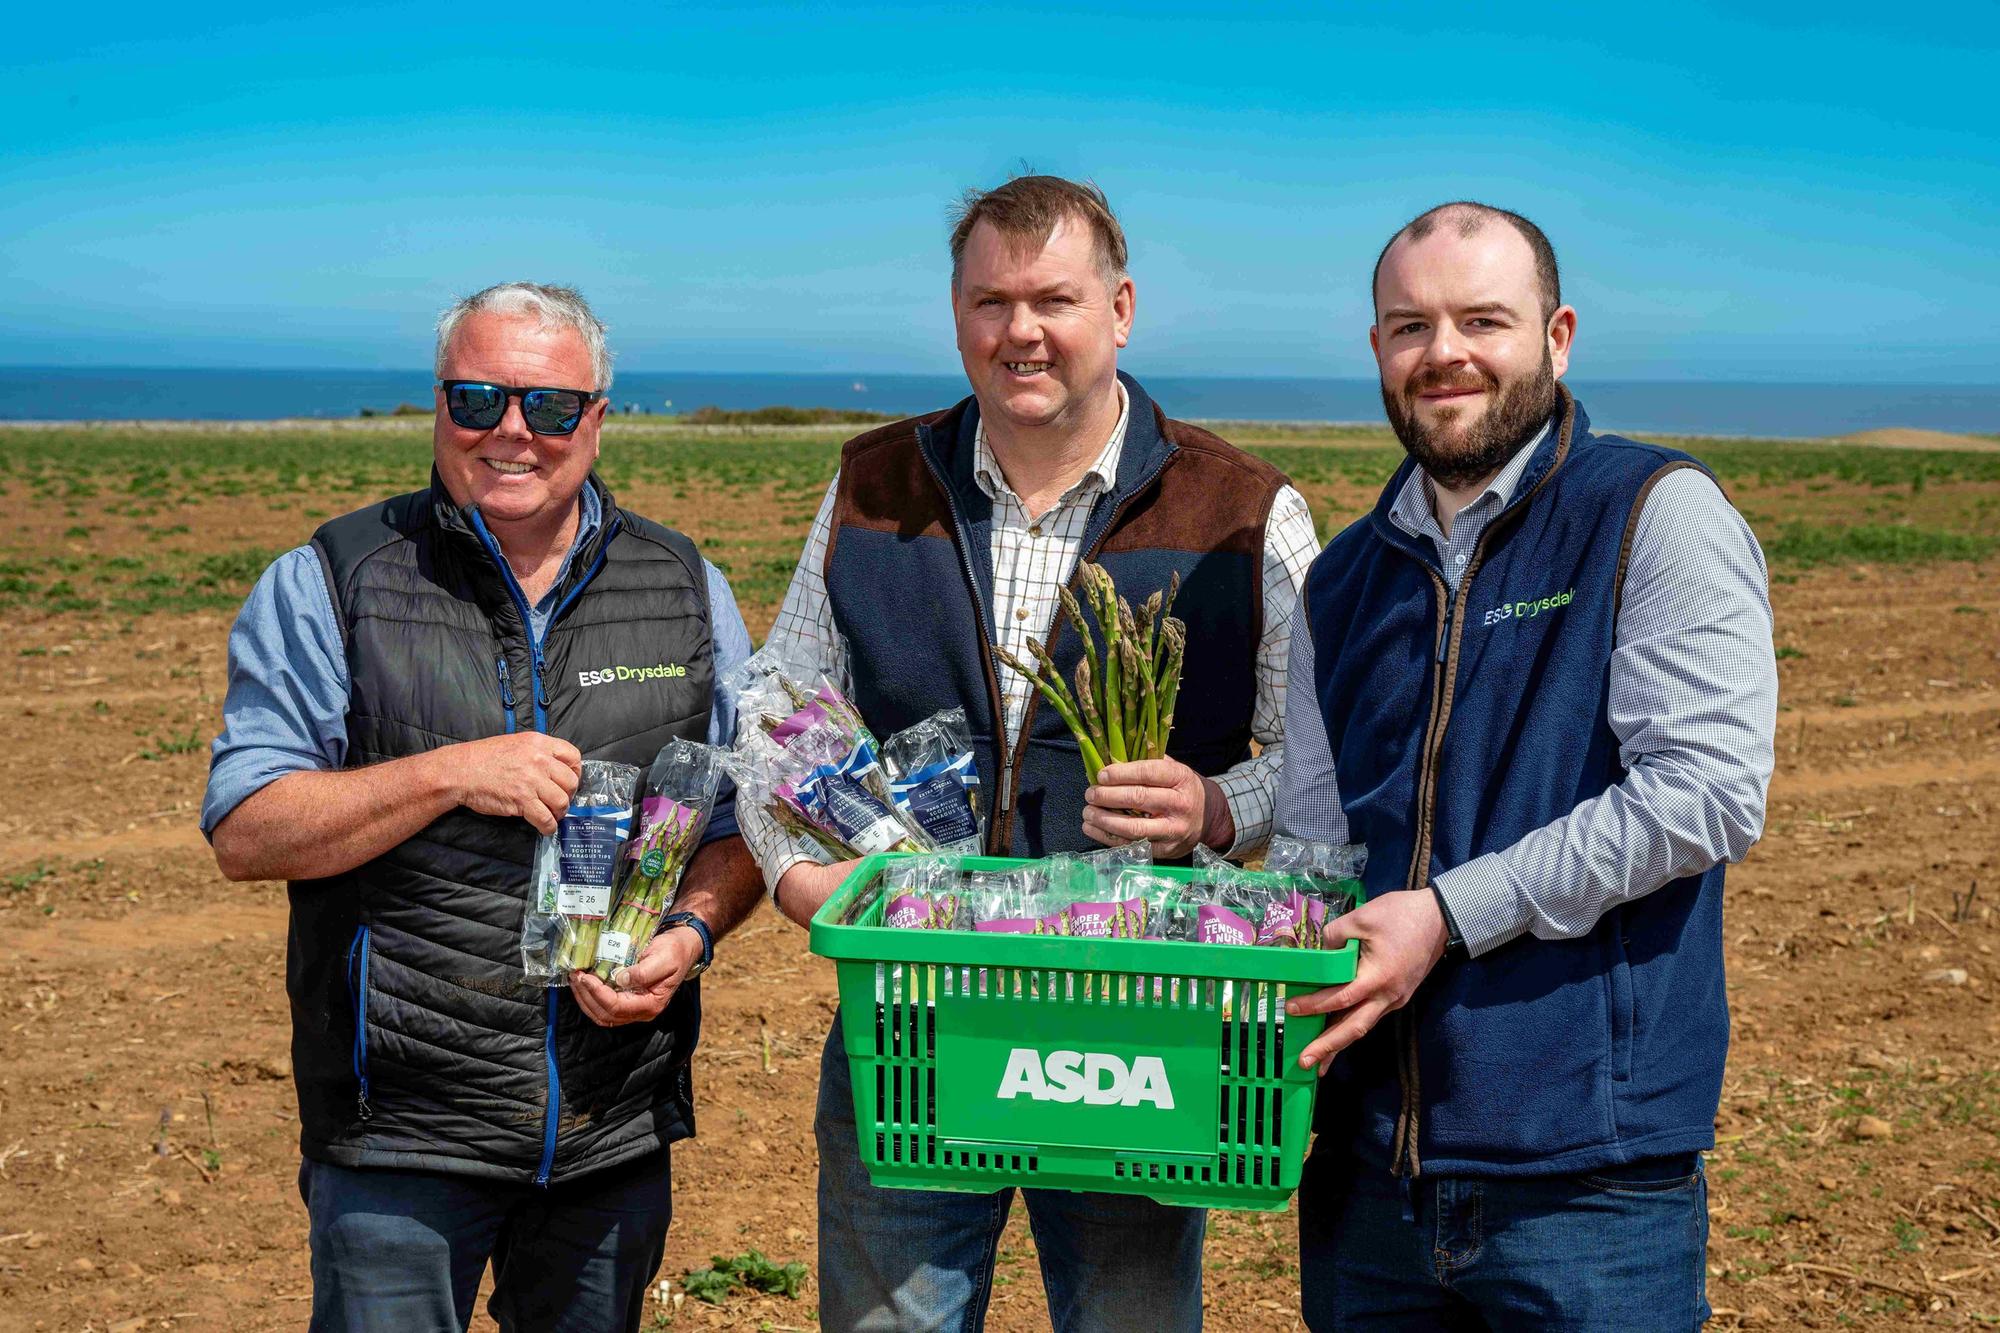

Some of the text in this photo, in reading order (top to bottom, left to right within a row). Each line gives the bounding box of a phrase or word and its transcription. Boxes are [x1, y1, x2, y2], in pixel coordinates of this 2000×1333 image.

[1484, 604, 1512, 626] ESG
[579, 662, 686, 686] ESG Drysdale
[923, 808, 956, 824] ASPARAGUS
[930, 803, 958, 816] SCOTTISH
[966, 844, 975, 852] 26
[586, 896, 596, 904] 26
[1204, 917, 1220, 925] ASDA
[1204, 923, 1244, 941] TENDER
[997, 1048, 1175, 1110] ASDA
